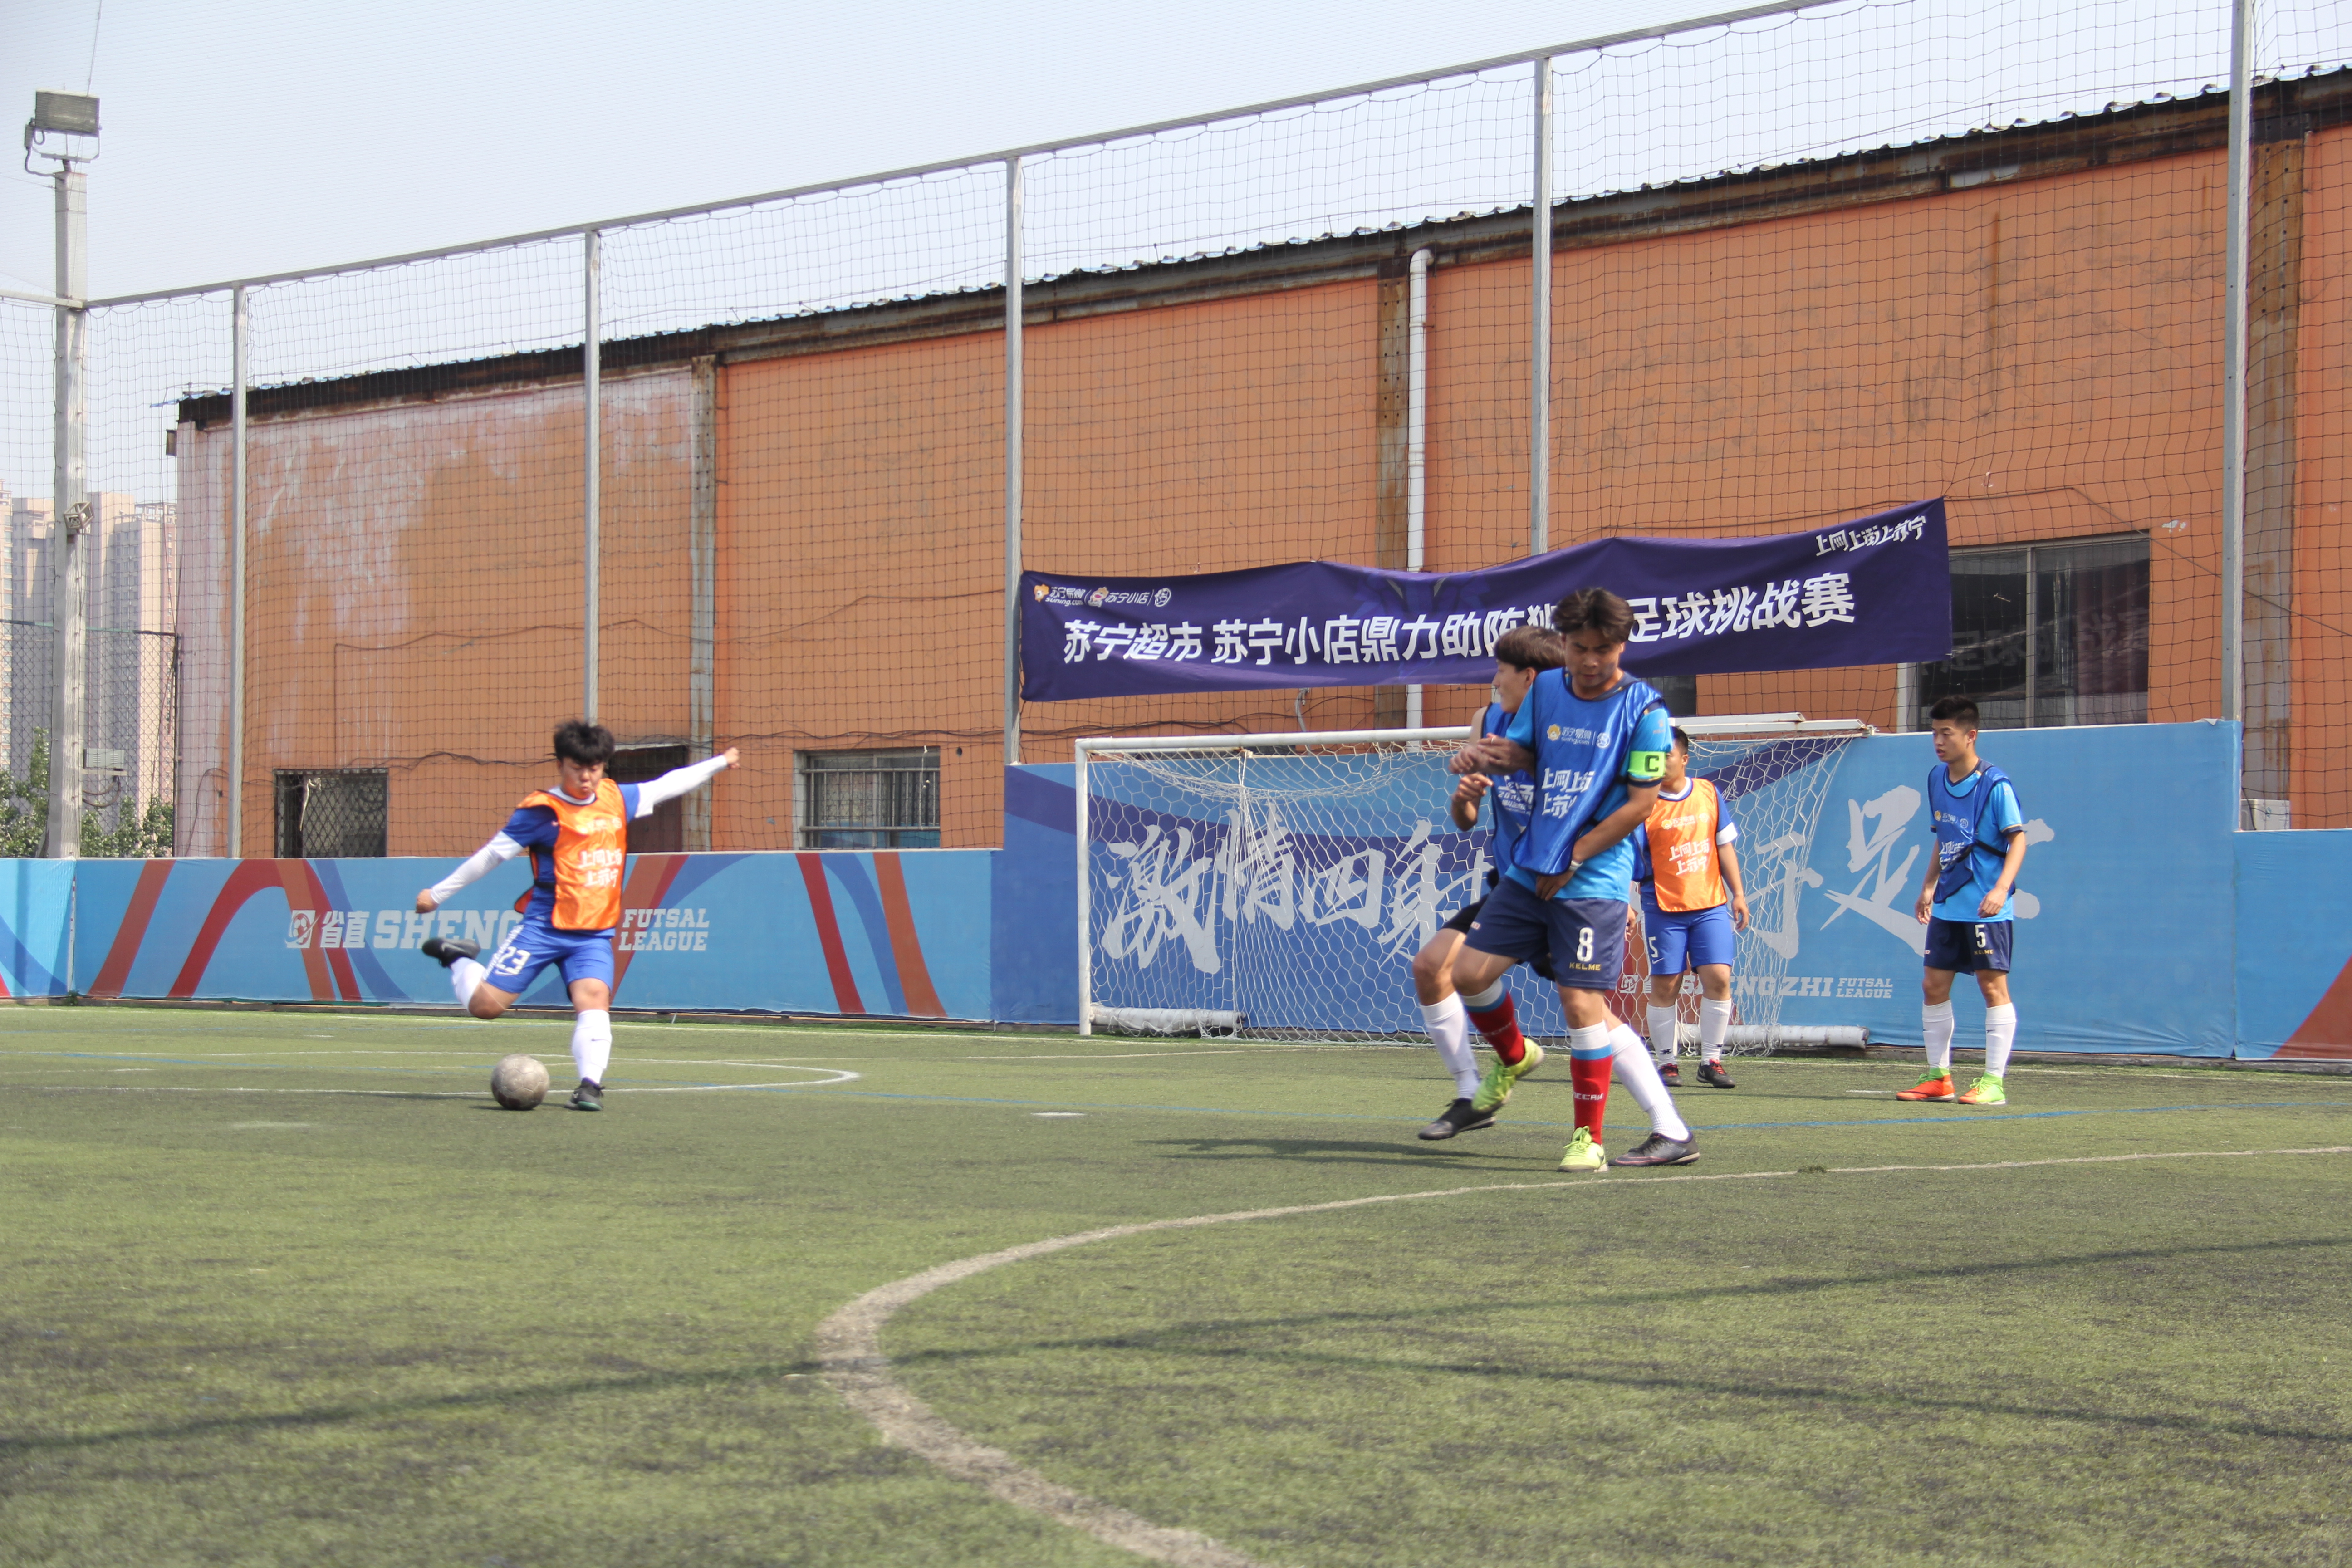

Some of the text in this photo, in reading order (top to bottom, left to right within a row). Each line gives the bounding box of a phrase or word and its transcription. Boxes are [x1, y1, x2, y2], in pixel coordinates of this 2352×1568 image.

[1816, 515, 1926, 556] 上网上街上苏宁
[1105, 592, 1150, 604] 苏宁小店
[1063, 620, 1202, 664] 苏宁超市
[1645, 755, 1659, 772] C
[622, 908, 710, 928] FUTSAL
[320, 911, 370, 948] 省直
[1974, 924, 1987, 948] 5
[618, 931, 709, 951] LEAGUE
[1577, 927, 1593, 962] 8
[1648, 936, 1658, 958] 5
[495, 946, 531, 975] 23
[1569, 962, 1602, 971] KELME
[1836, 988, 1893, 998] LEAGUE
[1838, 977, 1893, 988] FUTSAL
